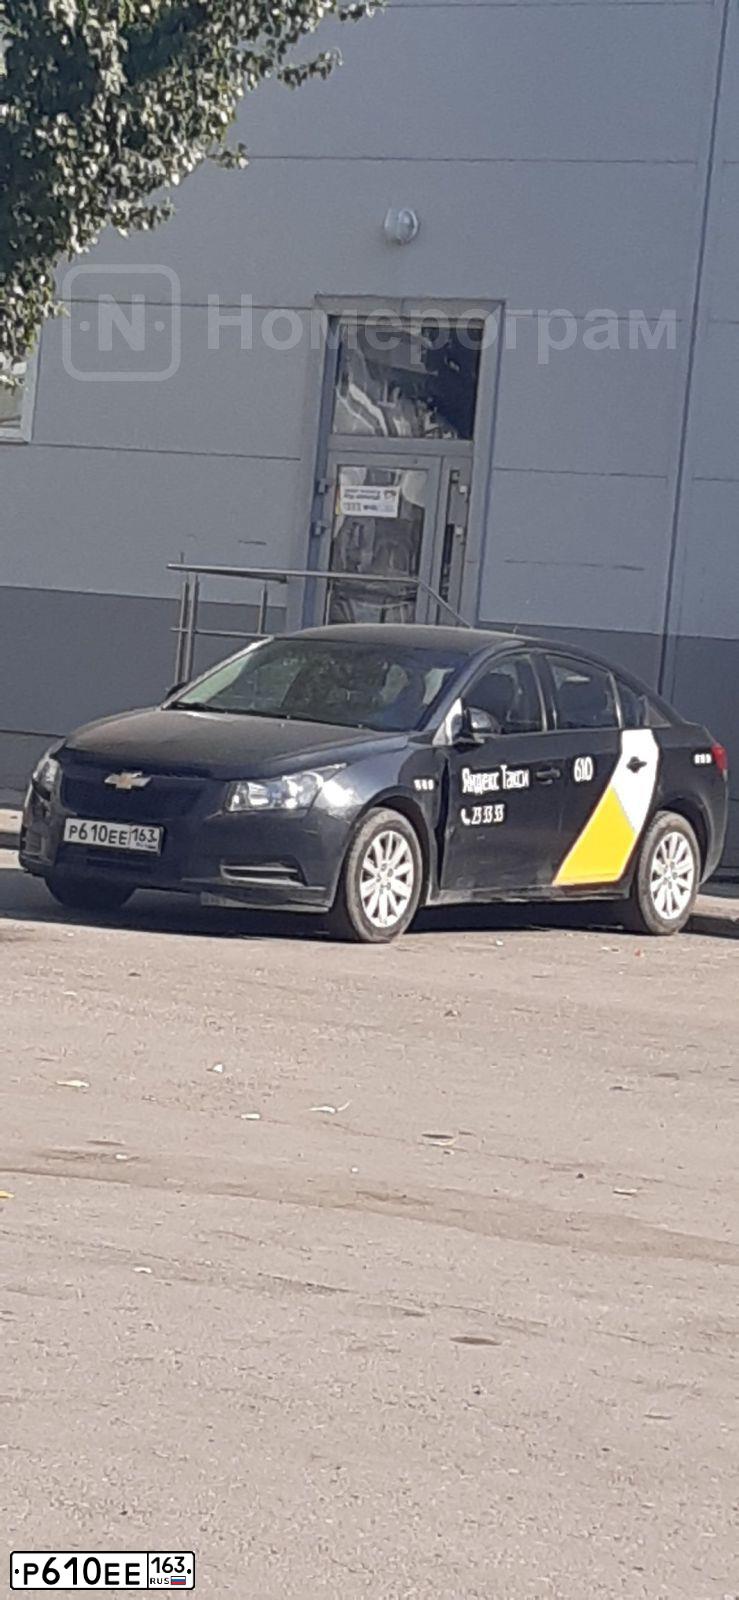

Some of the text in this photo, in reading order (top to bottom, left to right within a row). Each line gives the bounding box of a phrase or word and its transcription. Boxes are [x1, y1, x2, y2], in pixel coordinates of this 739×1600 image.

[462, 767, 500, 795] Яндекс
[500, 764, 529, 790] Такси
[574, 755, 594, 782] 610
[68, 822, 155, 846] Р610ЕЕ 163
